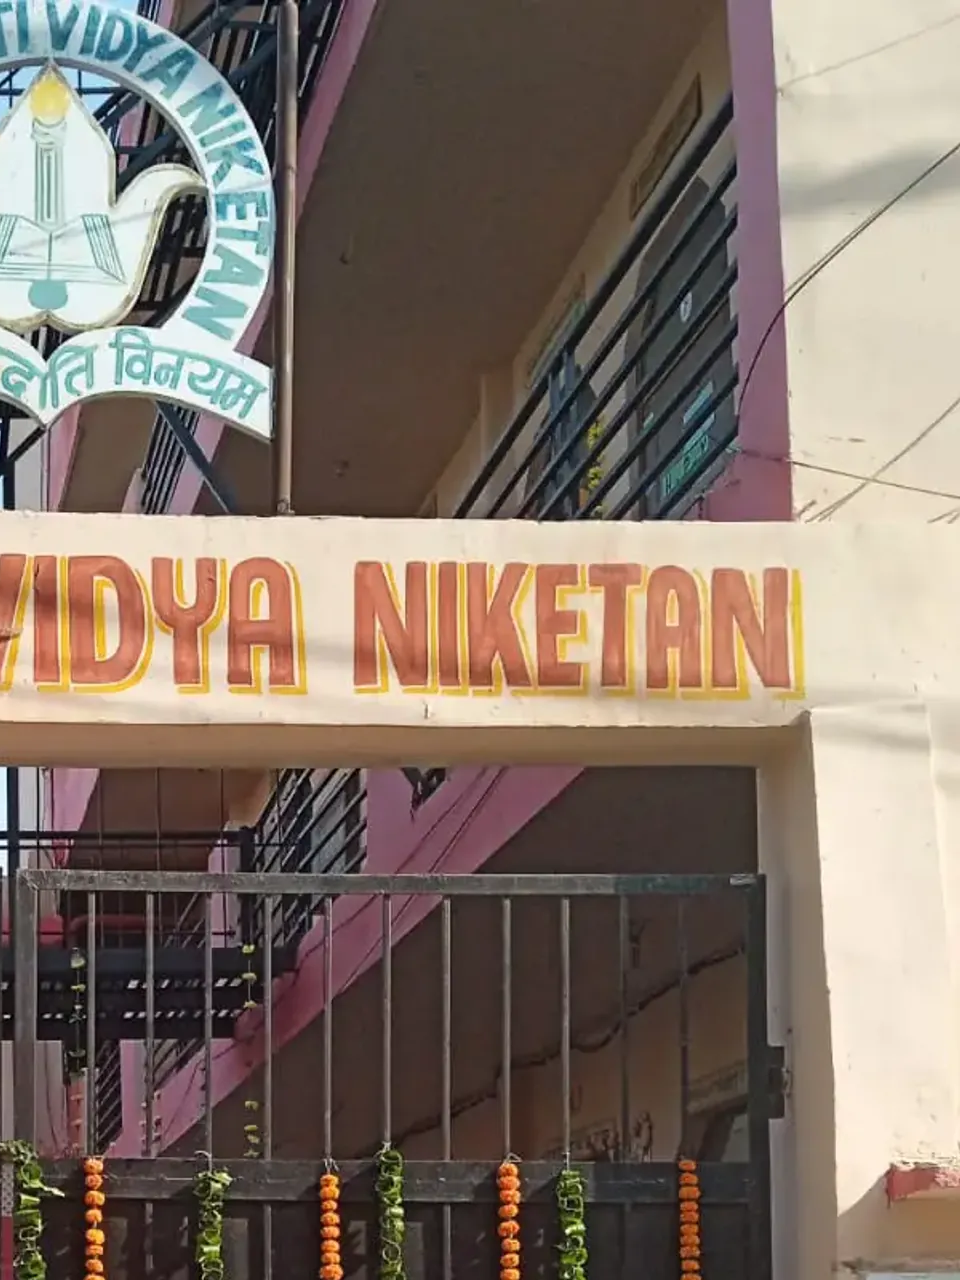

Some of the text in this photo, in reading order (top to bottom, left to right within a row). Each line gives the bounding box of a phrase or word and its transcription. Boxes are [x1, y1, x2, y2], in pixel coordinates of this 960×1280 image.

[46, 0, 199, 100] VIDYA
[176, 81, 269, 341] NIKETAN
[352, 561, 806, 700] NIKETAN
